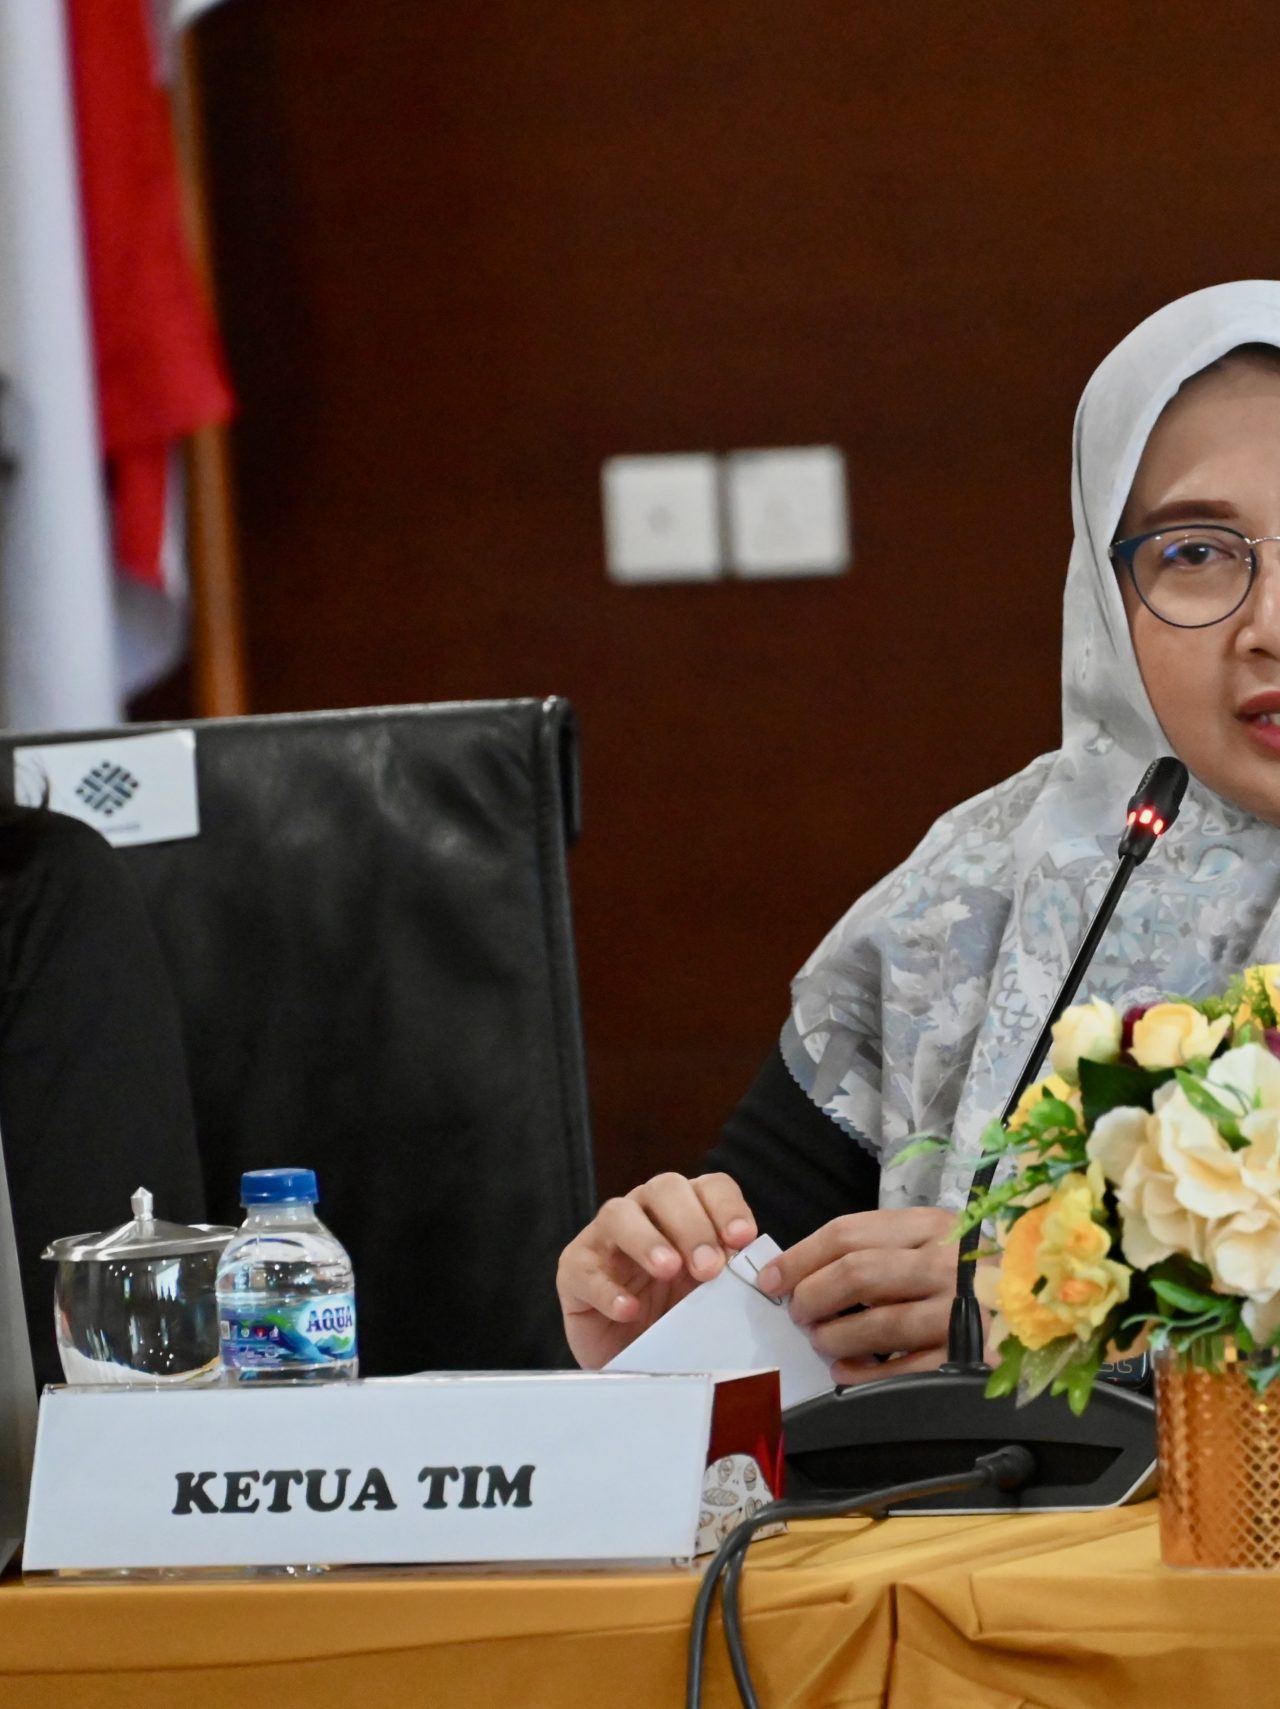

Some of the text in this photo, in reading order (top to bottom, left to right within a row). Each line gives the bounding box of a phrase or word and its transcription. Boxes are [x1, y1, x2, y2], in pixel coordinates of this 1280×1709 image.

[306, 1305, 353, 1333] AQUA
[171, 1464, 536, 1515] KETUA TIM
